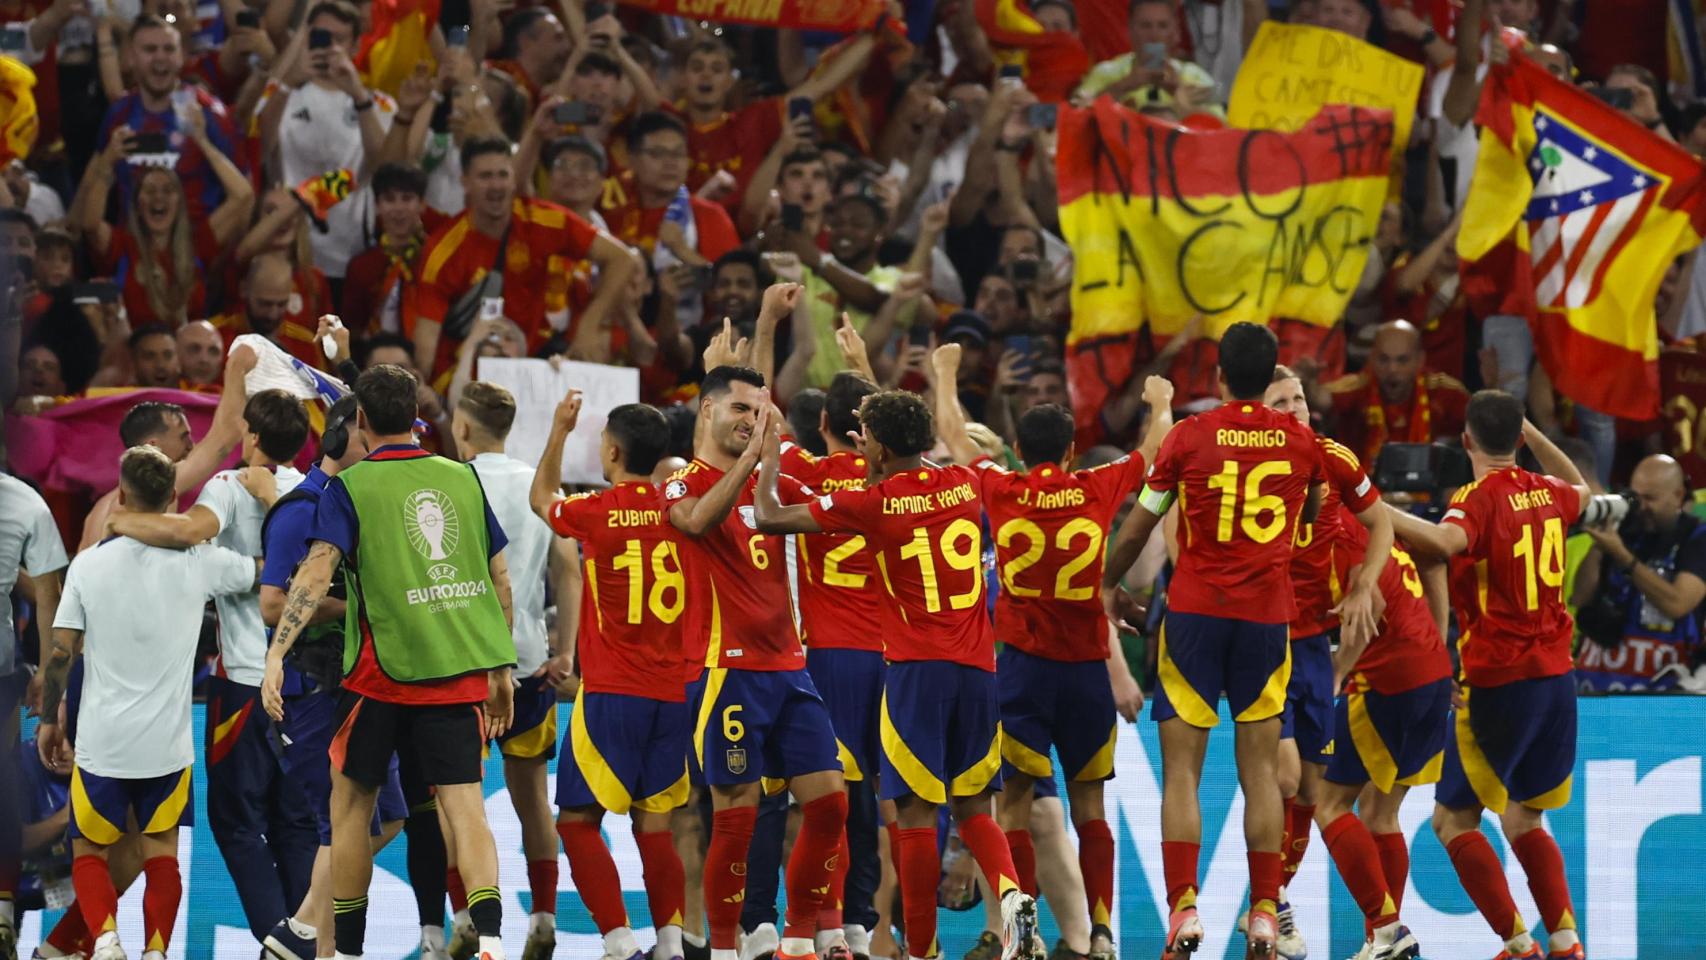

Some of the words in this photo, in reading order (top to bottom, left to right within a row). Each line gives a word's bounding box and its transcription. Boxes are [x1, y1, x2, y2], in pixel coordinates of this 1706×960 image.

[1257, 26, 1309, 64] ME
[1318, 32, 1364, 74] DAS
[1381, 55, 1417, 97] TU
[1088, 115, 1307, 221] NICO
[1217, 428, 1286, 448] RODRIGO
[822, 478, 867, 493] OYAR
[882, 494, 935, 515] LAMINE
[938, 482, 977, 508] YAMAL
[1036, 488, 1085, 509] NAVAS
[1207, 460, 1292, 544] 16
[608, 509, 661, 528] ZUBIM
[748, 534, 769, 570] 6
[901, 518, 982, 613] 19
[997, 517, 1103, 600] 22
[1513, 517, 1566, 612] 14
[429, 566, 458, 581] UEFA
[612, 539, 685, 625] 18
[428, 599, 471, 614] GERMANY
[722, 704, 745, 742] 6
